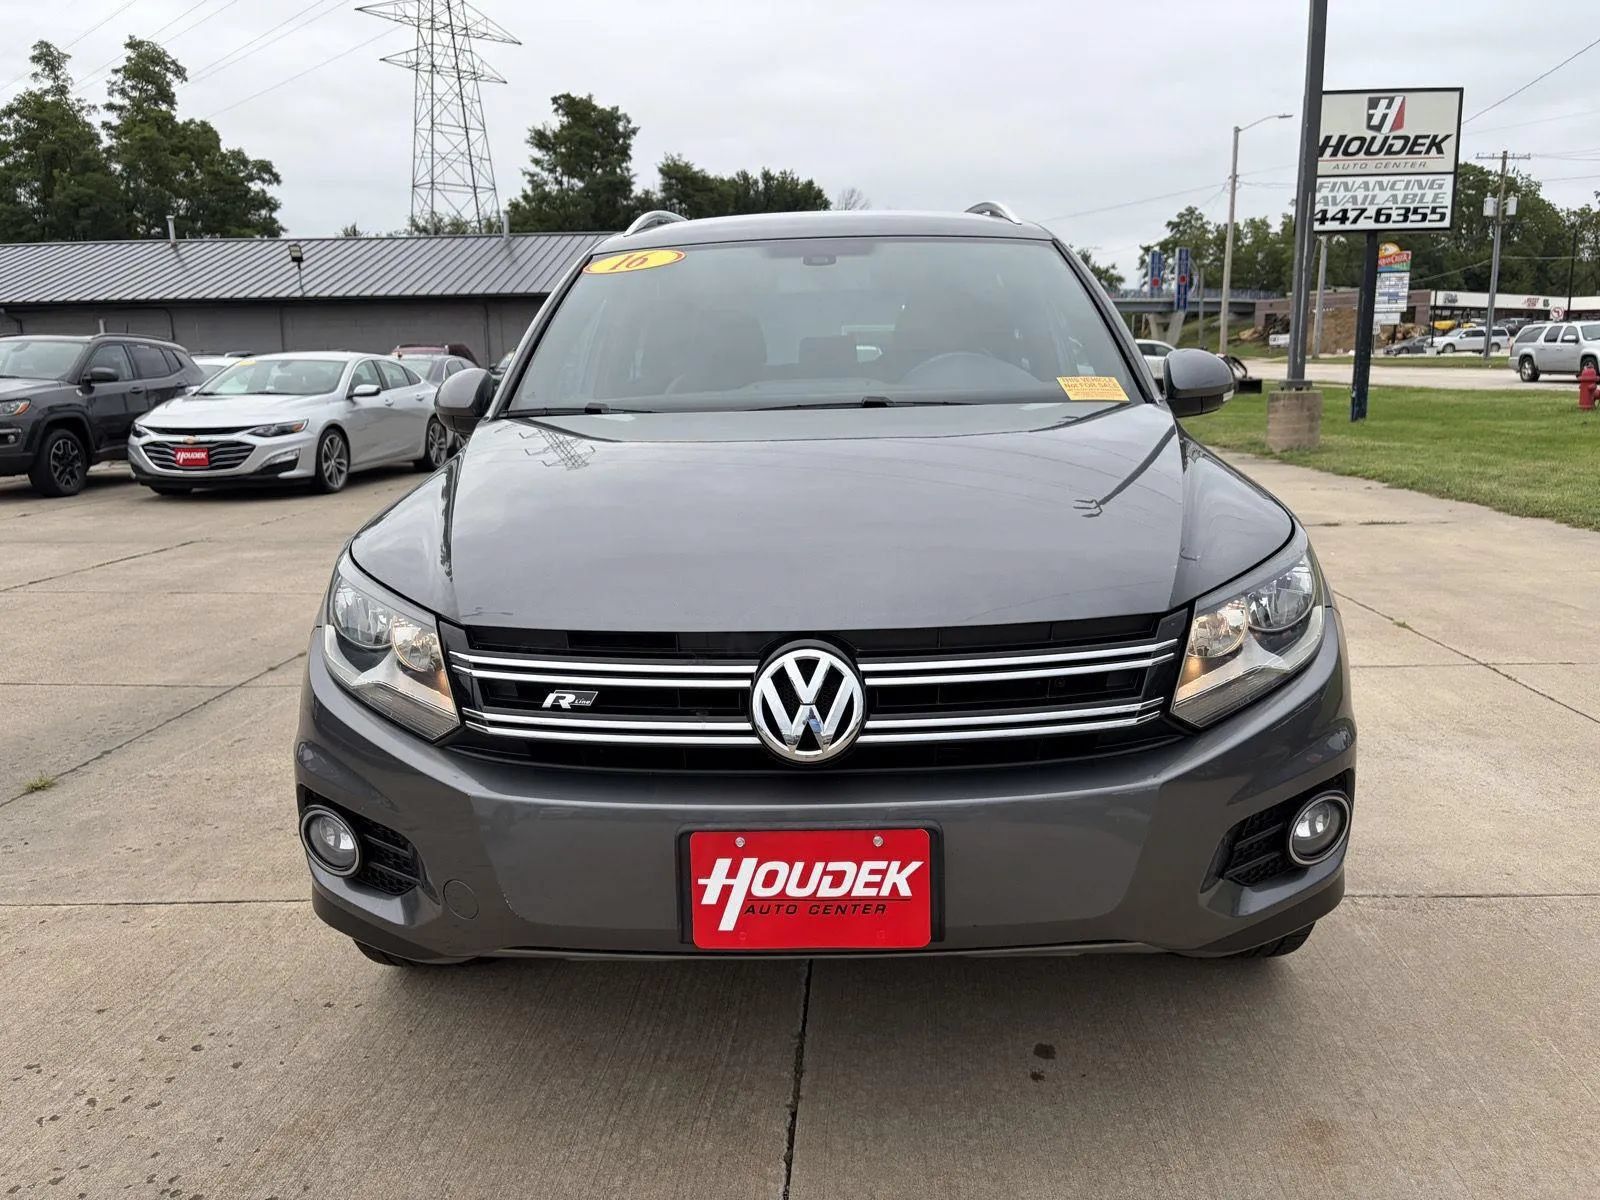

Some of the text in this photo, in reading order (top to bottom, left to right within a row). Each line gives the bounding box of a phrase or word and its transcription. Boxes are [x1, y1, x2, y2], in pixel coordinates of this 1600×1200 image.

[1318, 134, 1453, 157] HOUDEK
[1374, 161, 1427, 169] CENTER
[1317, 178, 1446, 193] FINANCING
[1316, 192, 1447, 207] AVAILABLE
[1314, 206, 1448, 225] 447-6355
[609, 251, 657, 271] 16
[176, 452, 207, 464] HOUDEK
[542, 693, 576, 709] R
[697, 857, 924, 932] HOUDEK
[744, 903, 887, 915] AUTO CENTER
